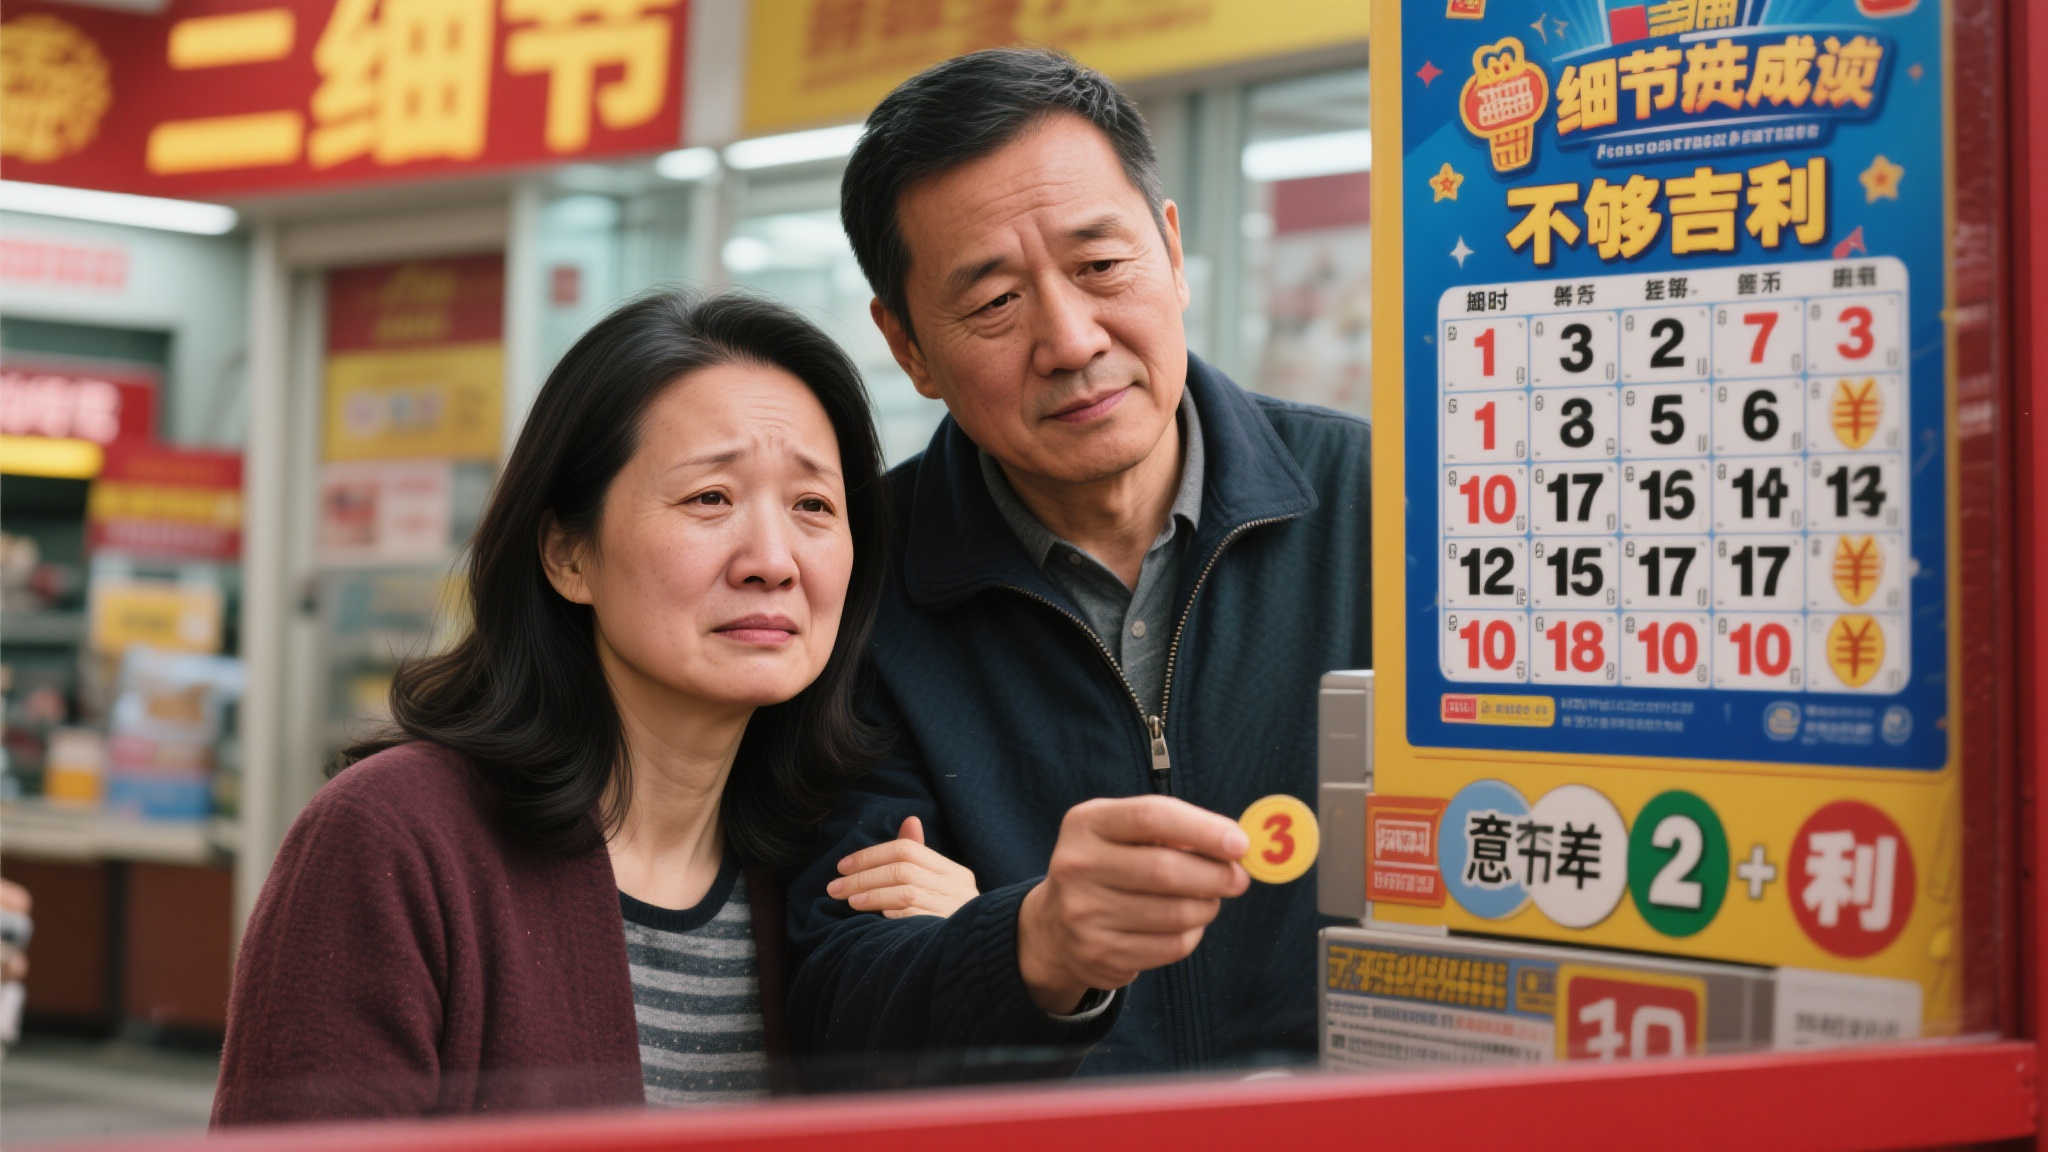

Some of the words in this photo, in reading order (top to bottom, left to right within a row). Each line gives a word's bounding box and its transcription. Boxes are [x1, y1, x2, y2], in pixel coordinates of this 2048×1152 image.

[146, 0, 674, 175] 二细节
[1505, 157, 1830, 265] 不够吉利
[1474, 327, 1495, 377] 1
[1560, 323, 1594, 373] 3
[1650, 318, 1685, 368] 2
[1743, 311, 1779, 364] 7
[1837, 306, 1875, 360] 3
[1474, 401, 1496, 451] 1
[1650, 394, 1685, 445] 5
[1742, 389, 1780, 442] 6
[1459, 474, 1517, 524] 10
[1547, 473, 1604, 522] 17
[1732, 467, 1788, 519] 14
[1460, 547, 1514, 596] 12
[1547, 547, 1604, 597] 15
[1638, 546, 1697, 596] 17
[1731, 545, 1790, 597] 17
[1459, 619, 1516, 671] 10
[1545, 620, 1605, 673] 18
[1638, 621, 1698, 676] 10
[1729, 622, 1792, 677] 10
[1262, 813, 1295, 865] 3
[1649, 815, 1703, 910] 2
[1802, 830, 1898, 931] 利
